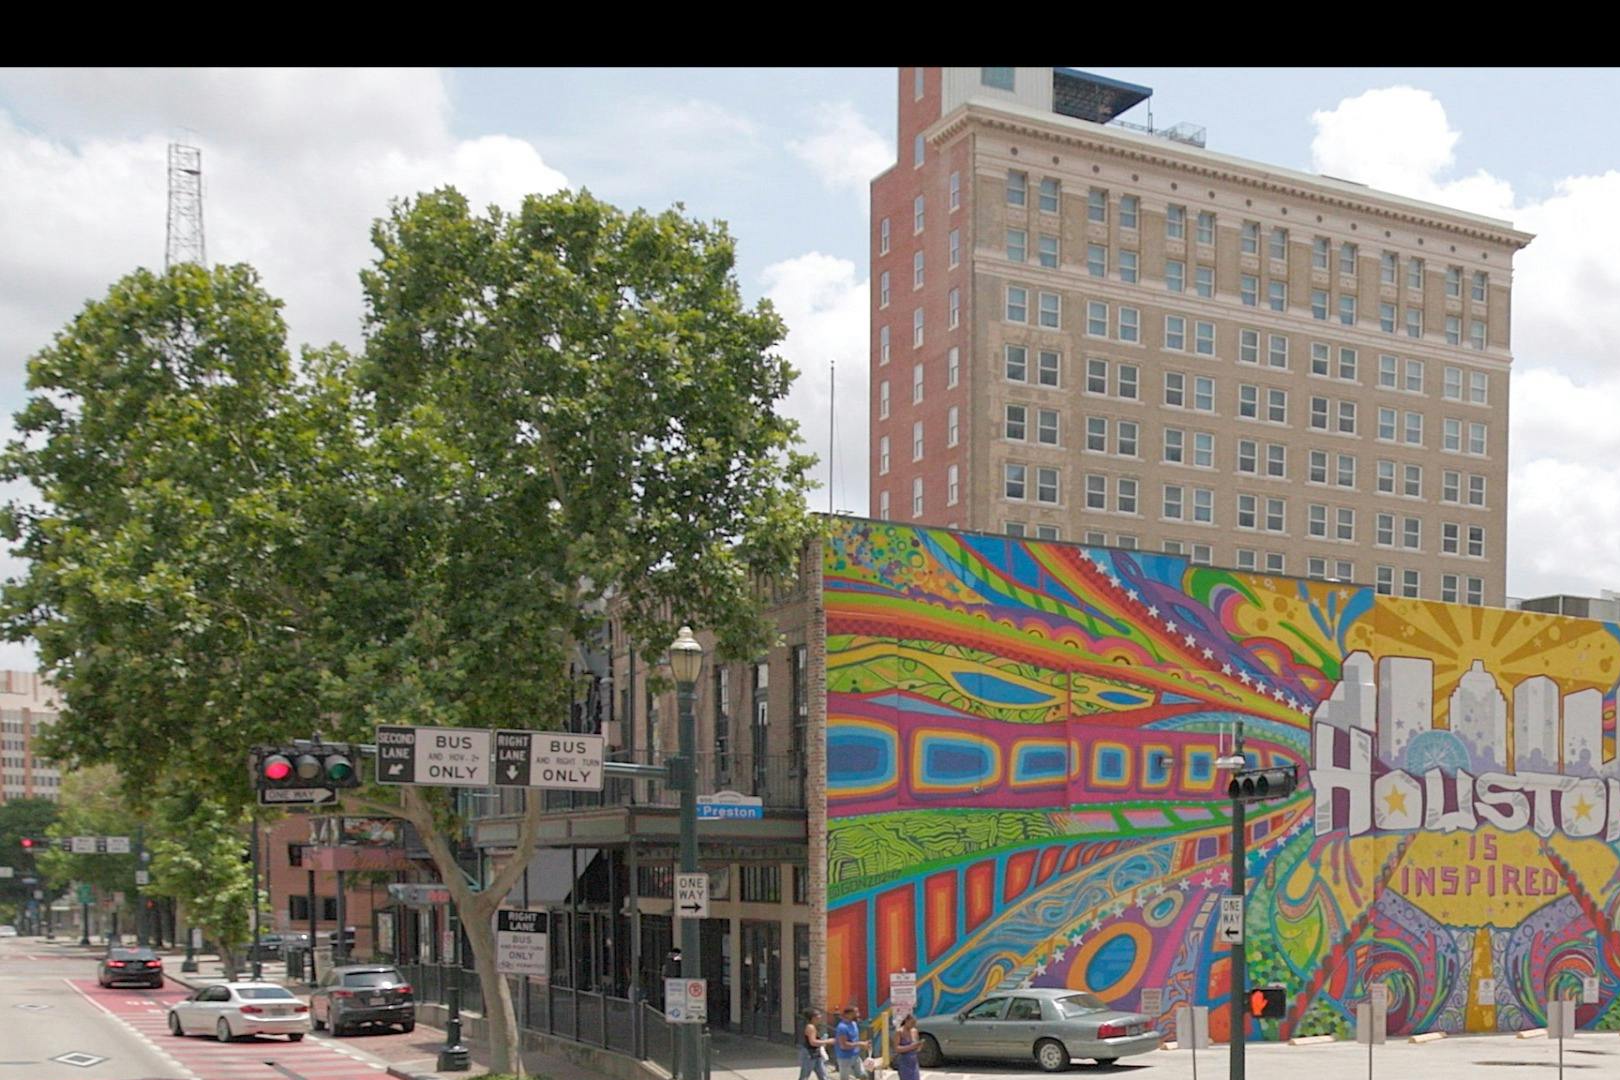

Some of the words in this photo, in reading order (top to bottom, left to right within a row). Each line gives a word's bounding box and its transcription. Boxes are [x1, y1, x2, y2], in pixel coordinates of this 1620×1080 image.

[378, 733, 415, 745] SECOND
[436, 735, 473, 750] BUS
[497, 735, 530, 747] RIGHT
[550, 740, 587, 754] BUS
[382, 747, 411, 760] LANE
[428, 752, 443, 761] AND
[499, 750, 527, 761] LANE
[536, 756, 551, 765] AND
[556, 757, 577, 766] RIGHT
[582, 758, 600, 767] TURN
[428, 765, 478, 779] ONLY
[542, 769, 591, 783] ONLY
[268, 788, 289, 799] ONE
[293, 788, 315, 799] WAY
[703, 805, 756, 817] Preston
[1467, 833, 1498, 861] IS
[680, 878, 704, 889] ONE
[1402, 865, 1559, 897] INSPIRED
[679, 890, 704, 900] WAY
[1223, 901, 1240, 911] ONE
[508, 912, 537, 922] RIGHT
[1223, 914, 1240, 923] WAY
[509, 922, 536, 931] LANE
[512, 935, 532, 944] BUS
[508, 951, 535, 960] ONLY
